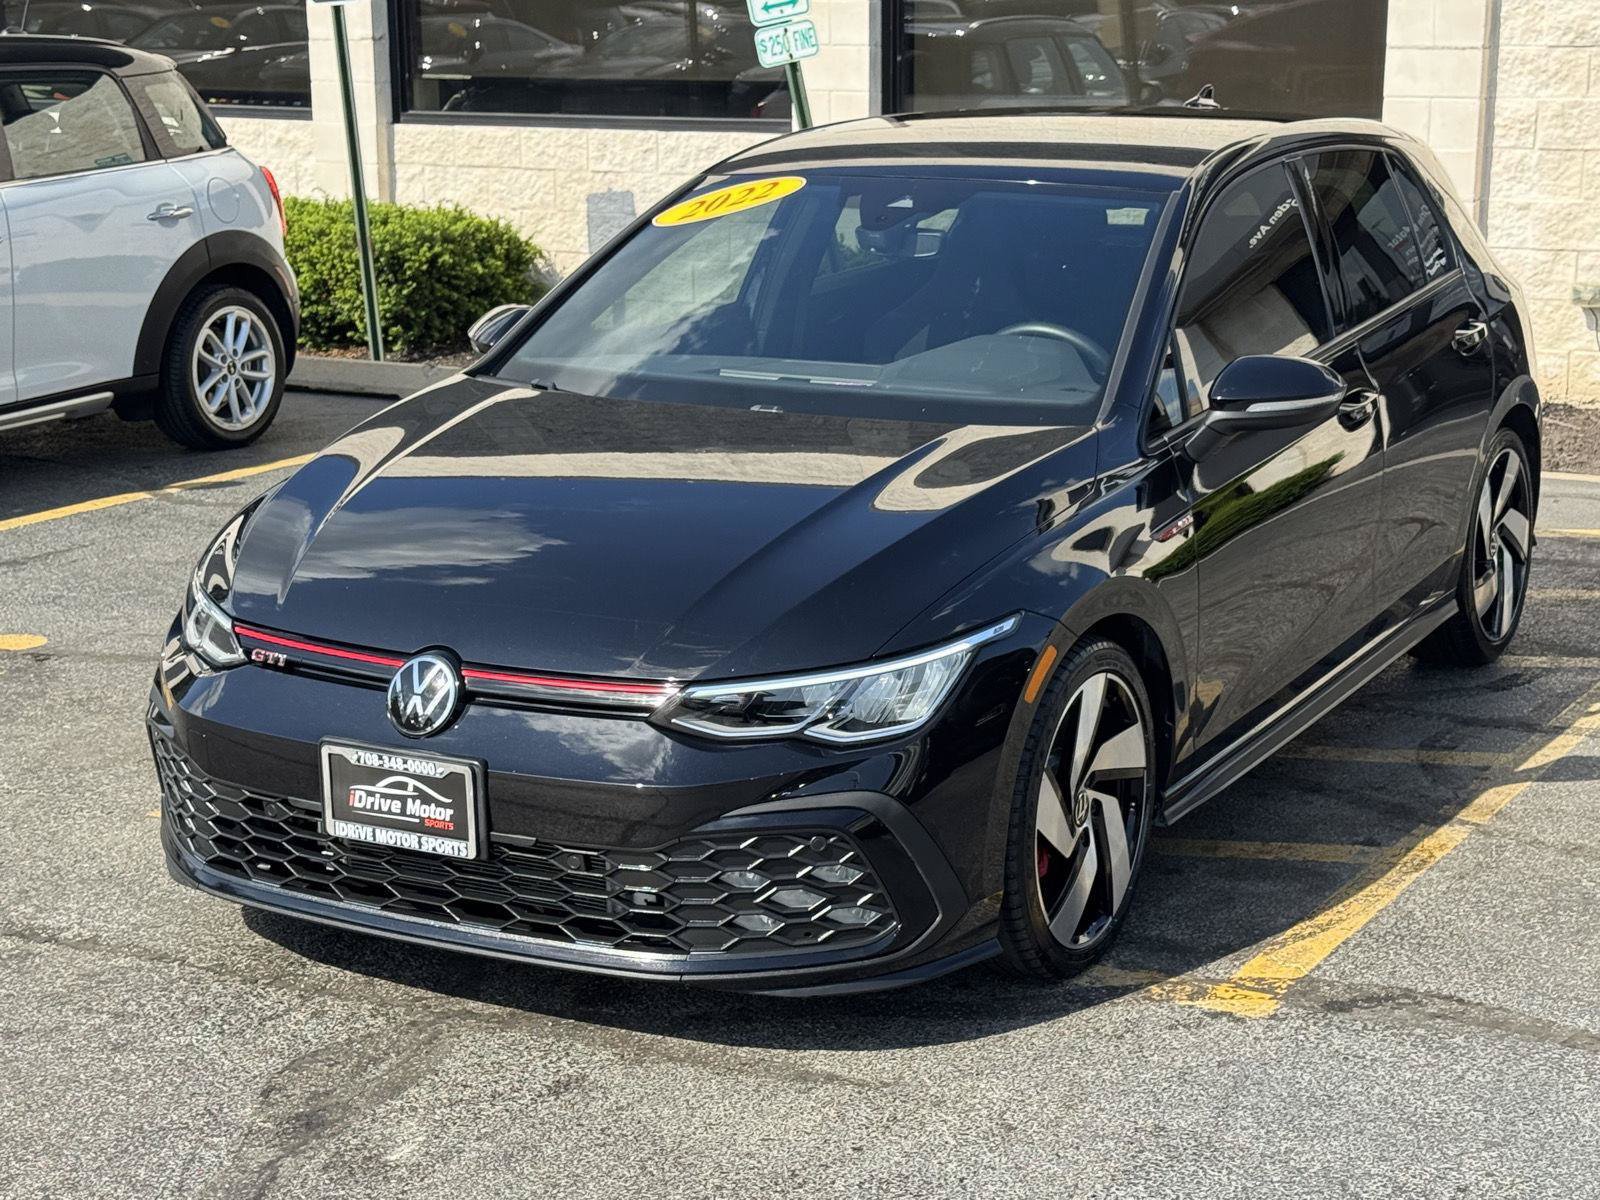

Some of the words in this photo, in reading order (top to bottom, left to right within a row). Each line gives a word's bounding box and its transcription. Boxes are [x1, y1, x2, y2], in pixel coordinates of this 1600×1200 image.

[793, 27, 818, 52] FINE
[677, 181, 780, 221] 2022
[251, 648, 288, 667] GTI
[357, 751, 436, 775] 708-348-0000
[348, 789, 402, 814] iDrive
[406, 798, 455, 822] Motor
[424, 818, 454, 831] SPORTS
[375, 828, 420, 850] MOTOR
[421, 836, 468, 858] SPORTS
